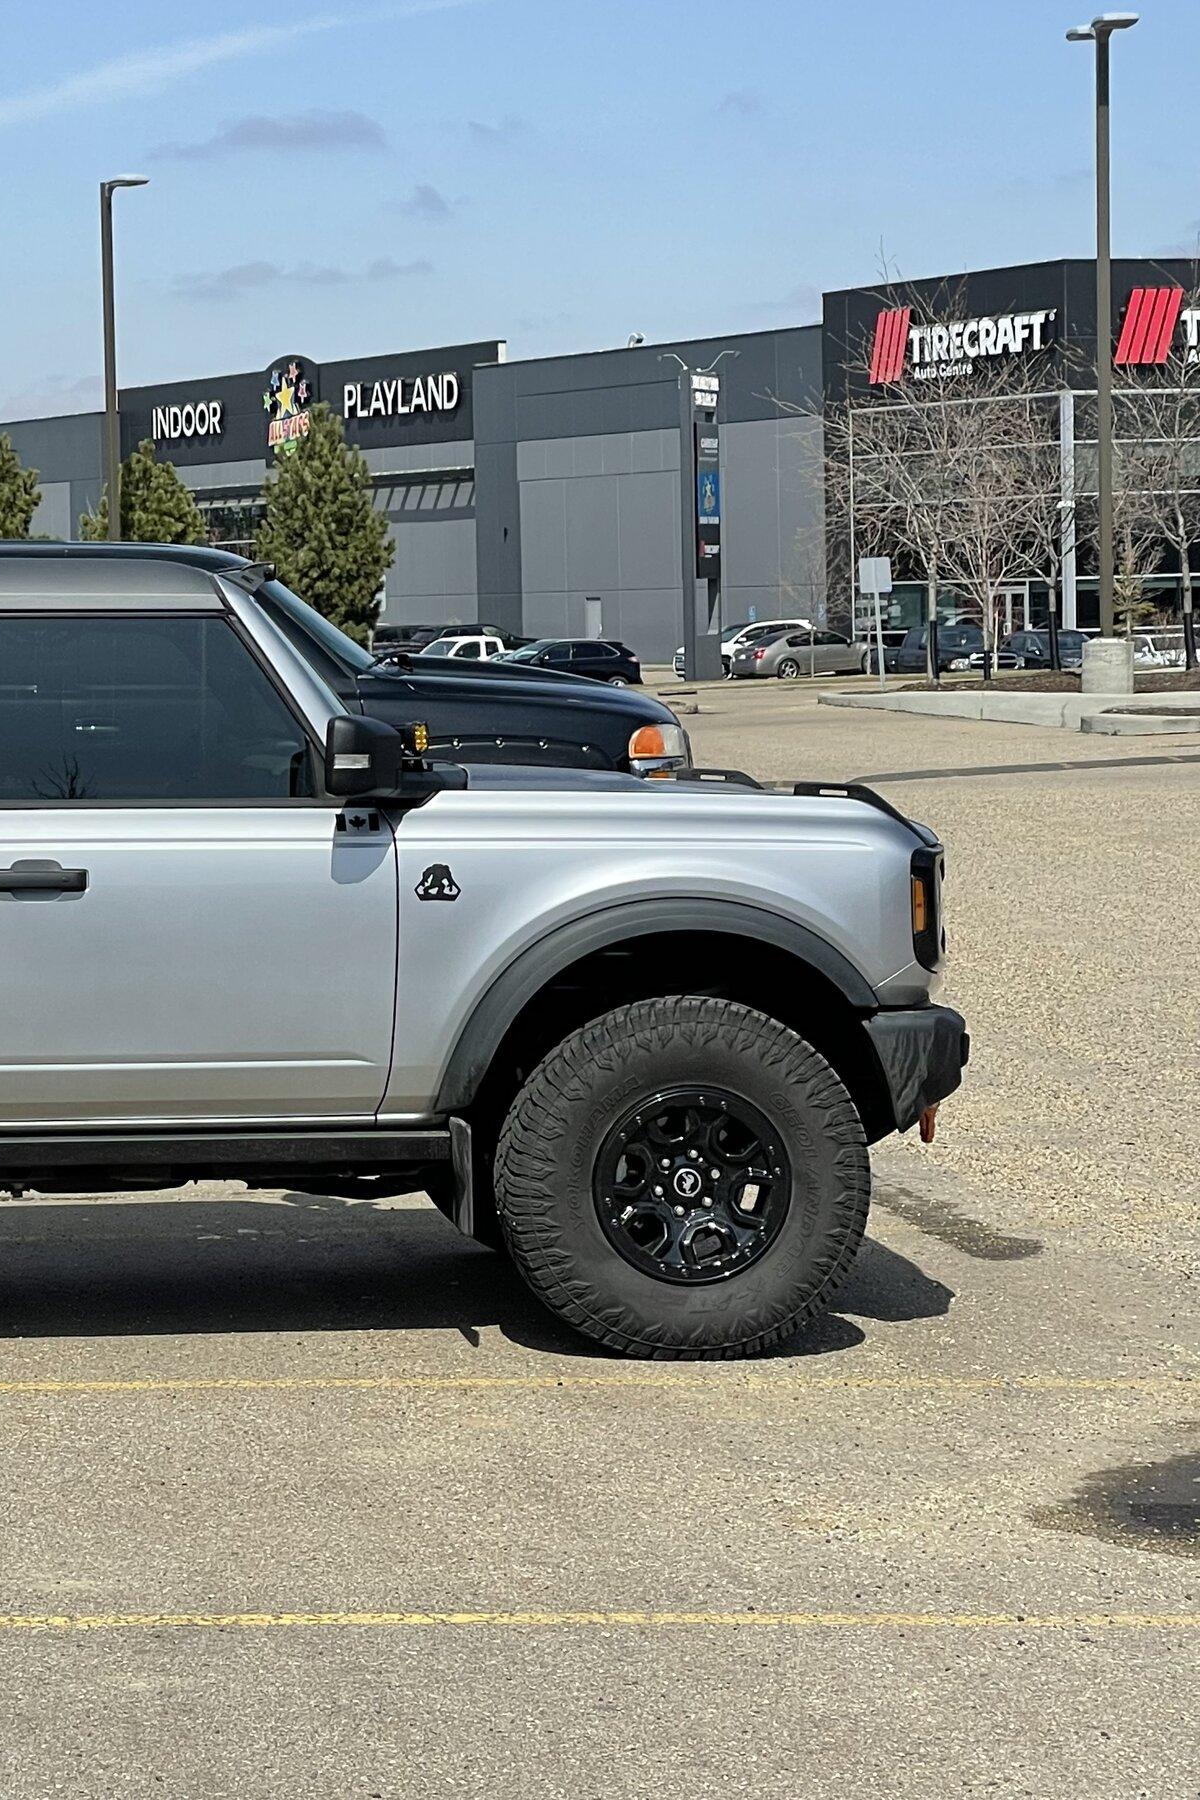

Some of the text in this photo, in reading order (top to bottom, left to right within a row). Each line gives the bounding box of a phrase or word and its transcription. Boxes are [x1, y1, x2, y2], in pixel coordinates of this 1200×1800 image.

[909, 313, 1046, 363] TIRECRAFT
[914, 361, 973, 380] Auto Centre
[153, 374, 458, 439] INDOOR PLAYLAND
[567, 1074, 641, 1231] YOKOHAMA
